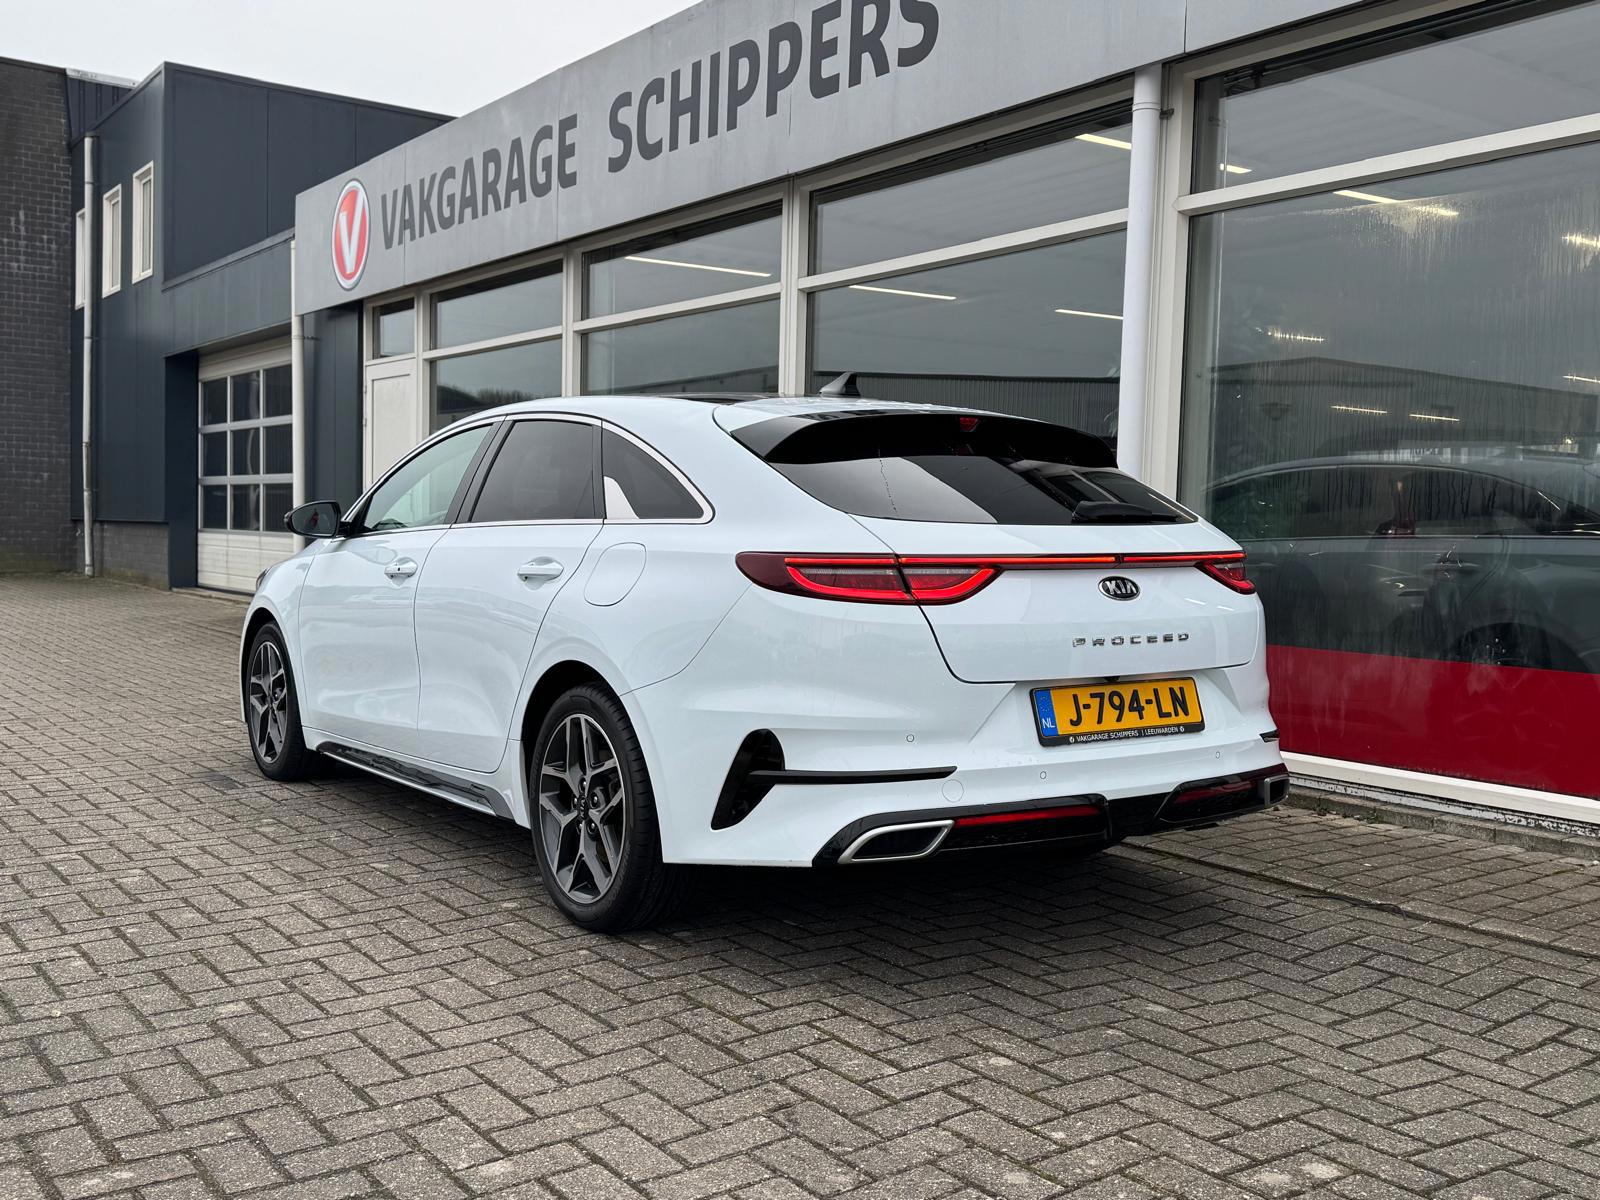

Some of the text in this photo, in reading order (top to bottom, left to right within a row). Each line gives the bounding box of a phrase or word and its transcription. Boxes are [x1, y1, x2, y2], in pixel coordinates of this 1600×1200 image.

[381, 114, 578, 250] VAKGARAGE
[608, 0, 939, 173] SCHIPPERS
[1104, 580, 1137, 595] KIA
[1072, 633, 1189, 647] PROCEED
[1069, 686, 1190, 727] J-794-LN
[1042, 718, 1055, 729] NL
[1076, 732, 1109, 742] VAKGARAGE
[1110, 729, 1138, 739] SCHIPPERS
[1145, 726, 1178, 736] LEEUWARDEN
